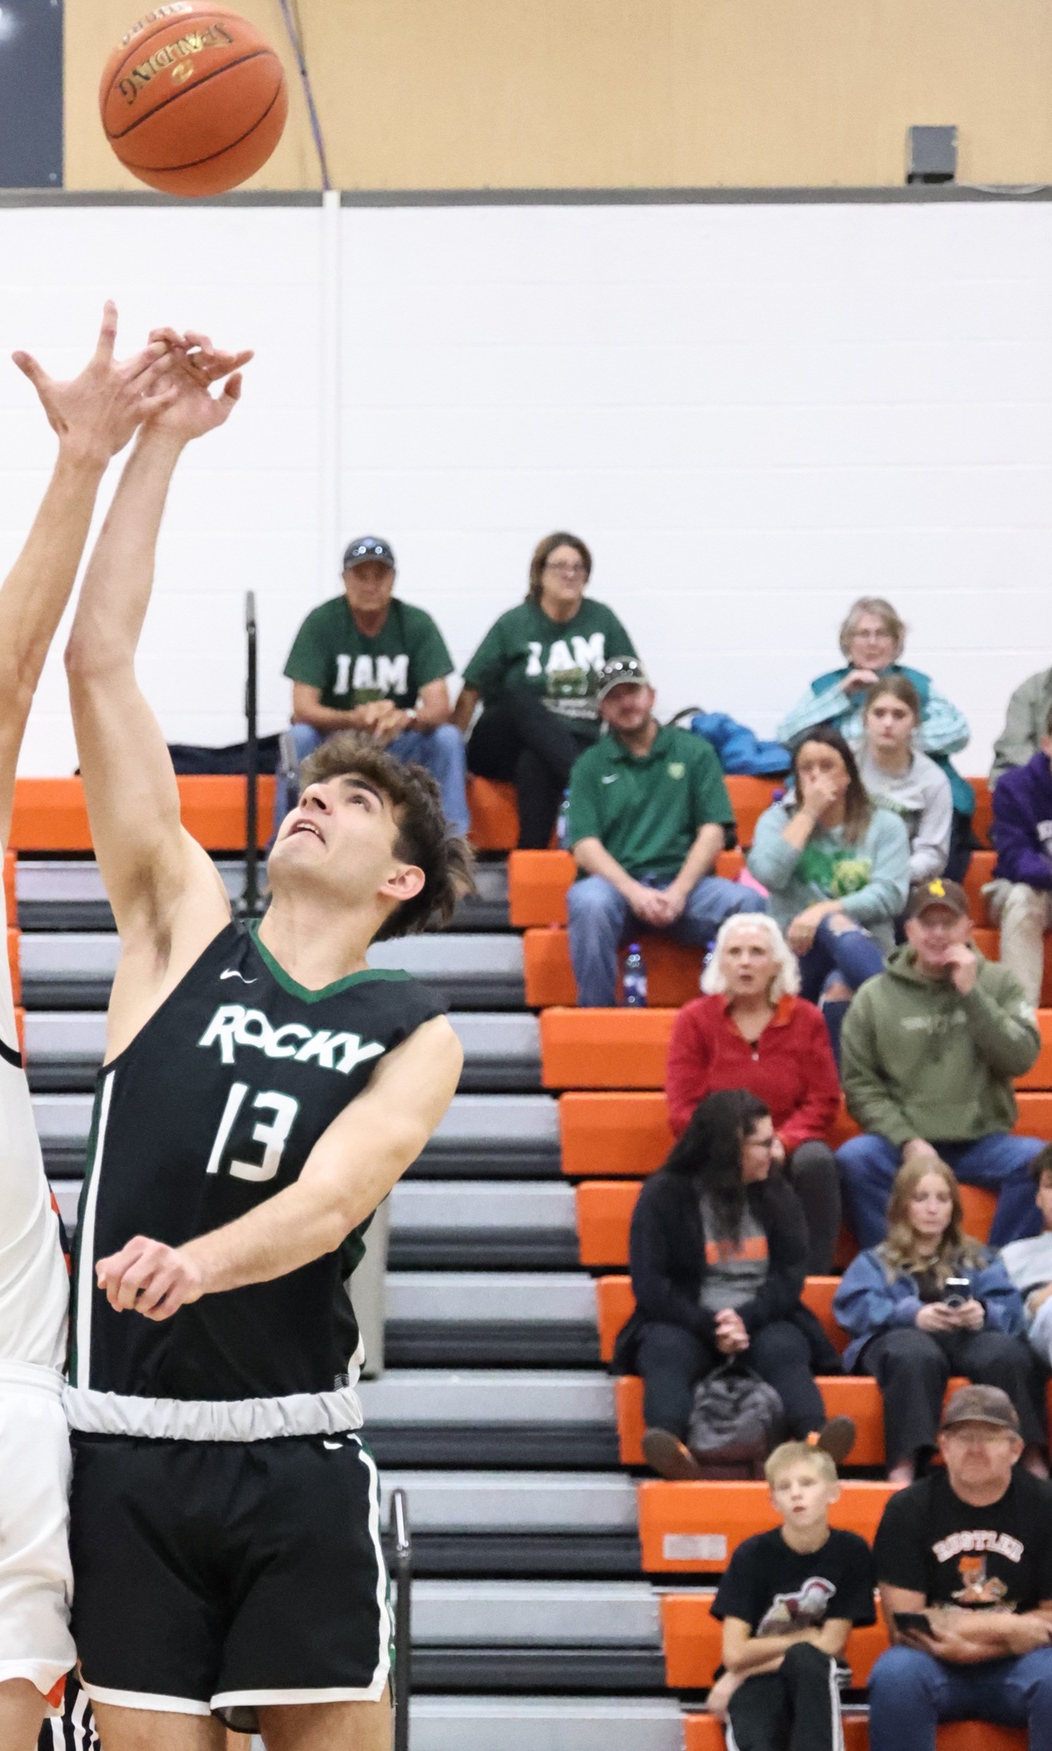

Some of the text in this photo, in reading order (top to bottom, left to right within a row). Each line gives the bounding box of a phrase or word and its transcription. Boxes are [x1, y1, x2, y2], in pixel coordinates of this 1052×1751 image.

[118, 22, 234, 106] SPALDING
[197, 1002, 386, 1075] ROCKY
[205, 1081, 300, 1183] 13
